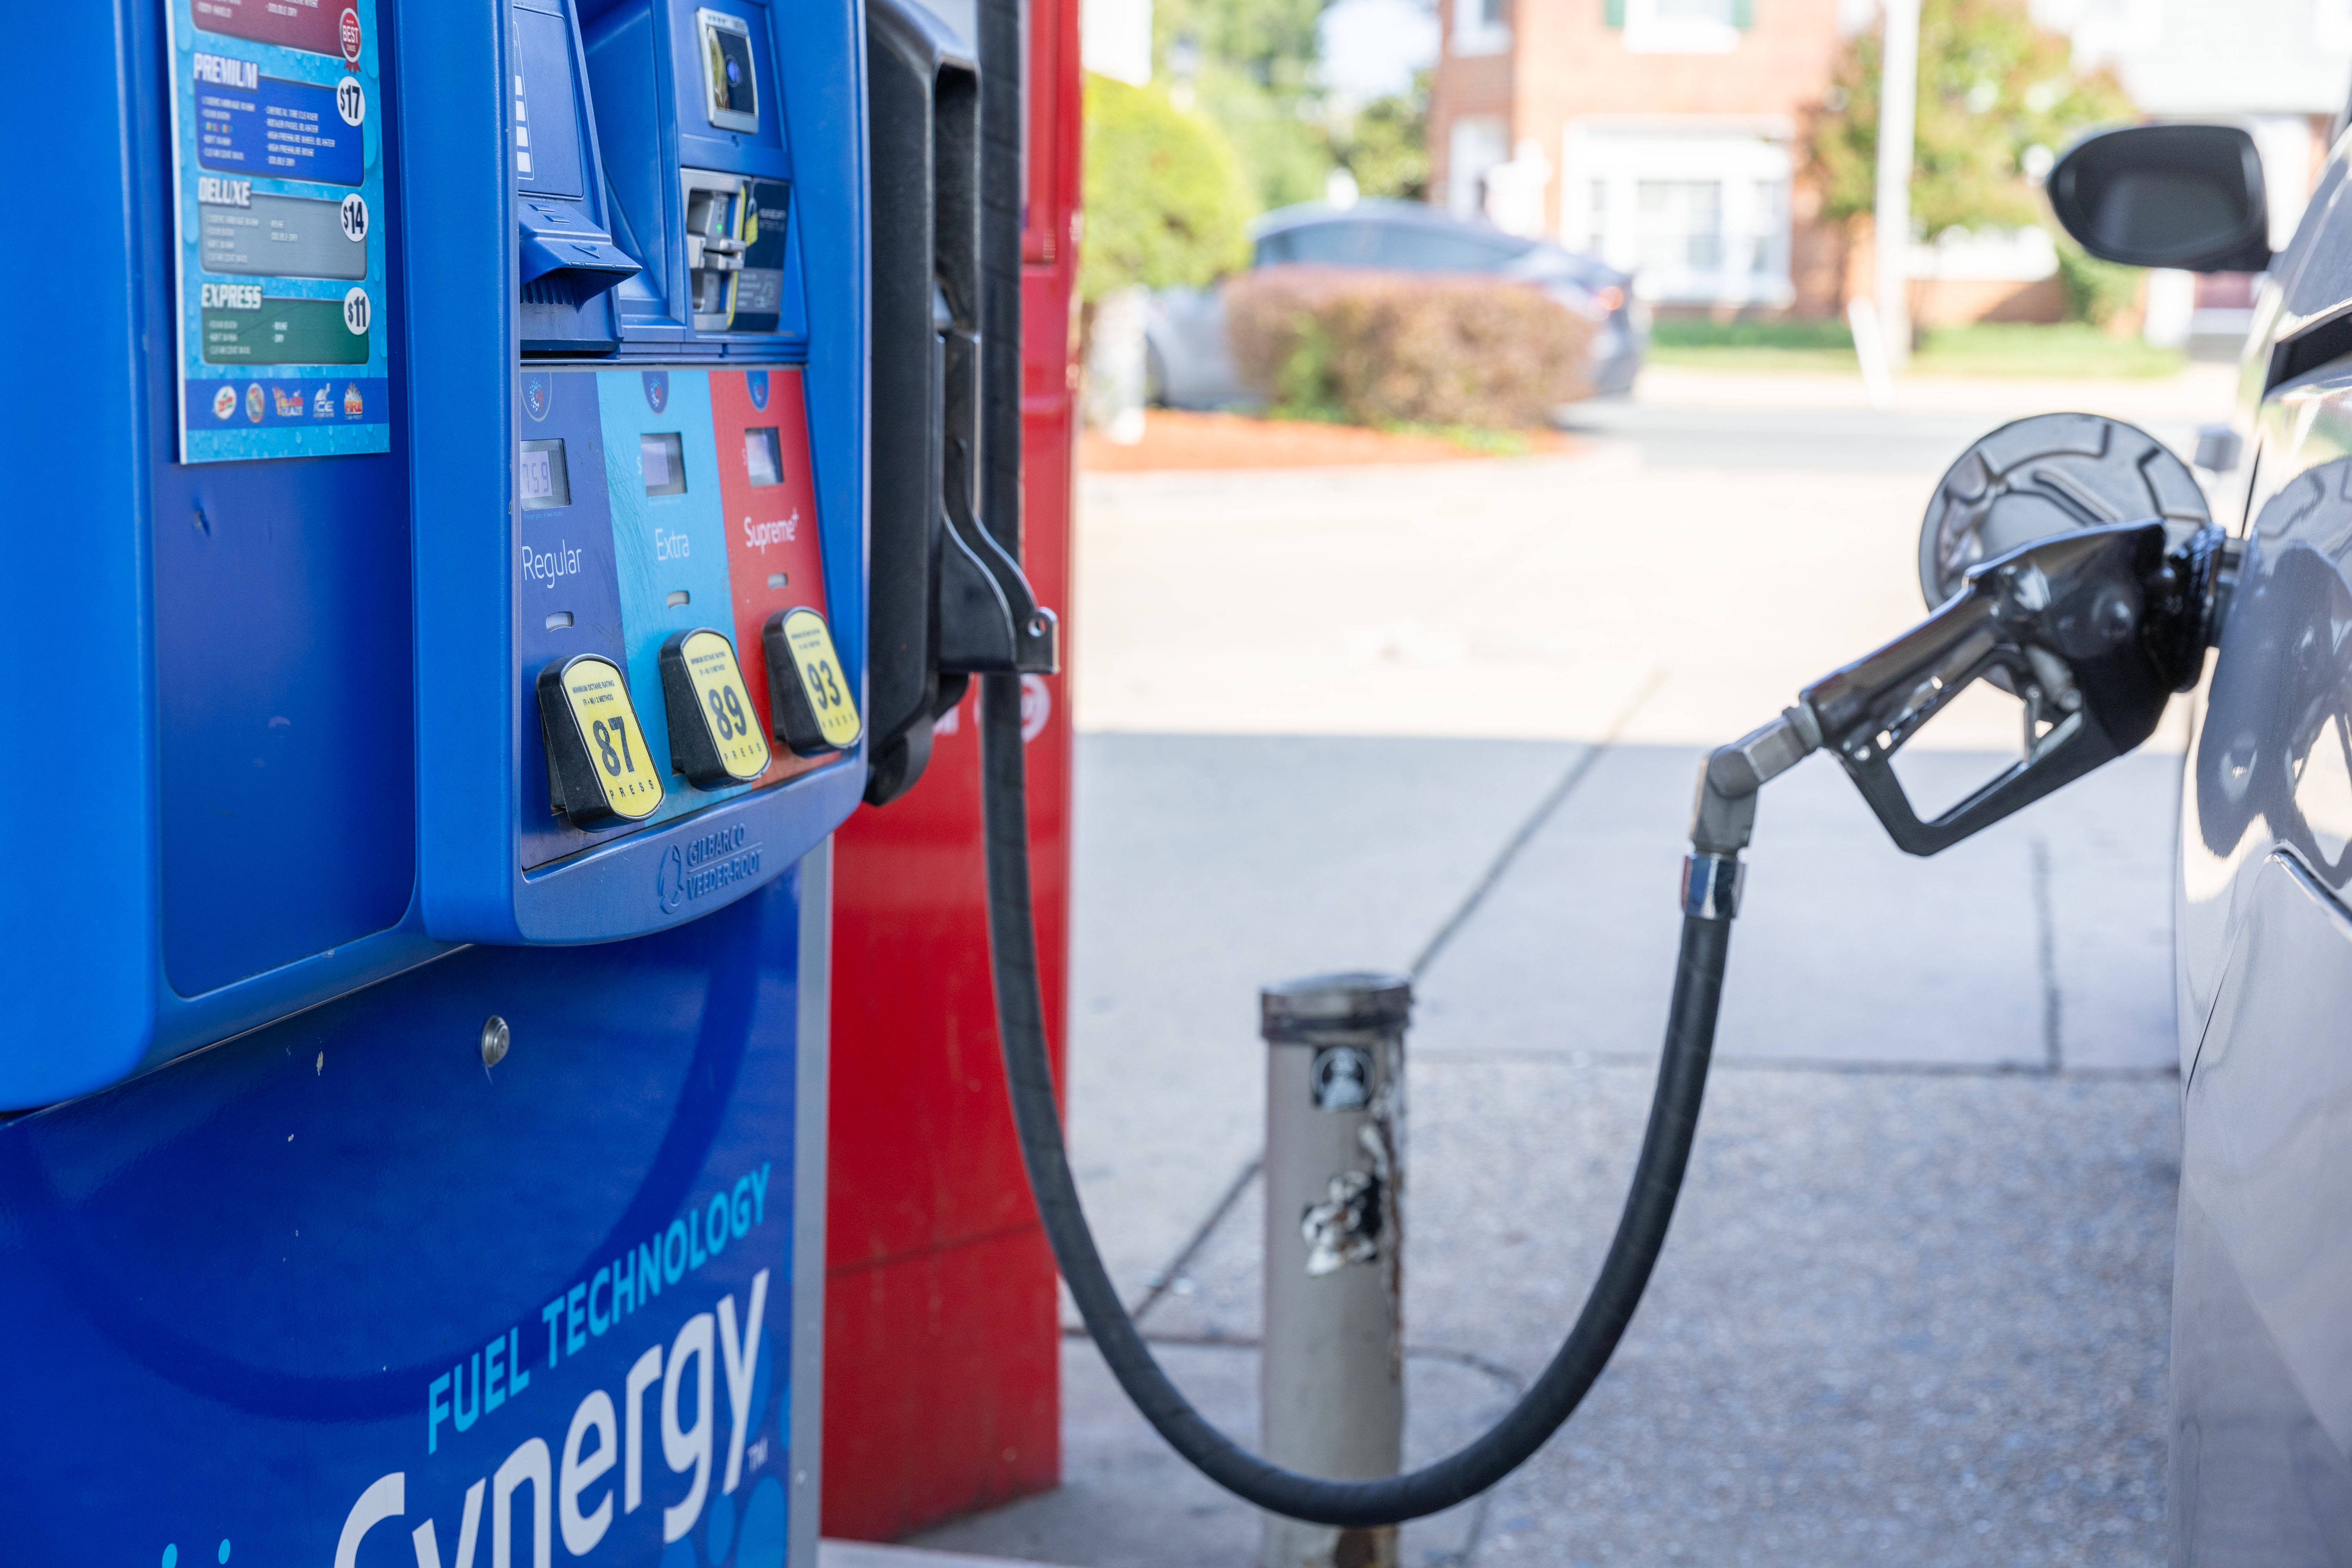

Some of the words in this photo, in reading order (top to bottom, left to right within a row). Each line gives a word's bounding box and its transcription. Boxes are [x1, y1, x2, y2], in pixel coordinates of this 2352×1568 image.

[342, 25, 358, 44] BEST
[193, 52, 258, 89] PREMIUM
[340, 84, 360, 119] $17
[198, 176, 251, 206] DELUXE
[343, 201, 364, 234] $14
[201, 283, 262, 309] EXPRESS
[348, 296, 366, 327] $11
[344, 400, 363, 414] FIRE
[655, 528, 690, 561] Extra
[521, 539, 582, 589] Regular
[572, 685, 588, 693] MINIMUM
[587, 682, 602, 691] OCTANE
[601, 680, 615, 688] RATING
[598, 694, 613, 702] METHOD
[807, 659, 841, 710] 93
[708, 685, 747, 740] 89
[593, 716, 635, 777] 87
[724, 742, 761, 762] PRESS
[609, 780, 654, 800] PRESS
[687, 823, 745, 867] GILBARCO
[686, 848, 764, 900] VEEDER-ROOT
[428, 1327, 530, 1455] FUEL
[542, 1161, 771, 1369] TECHNOLOGY
